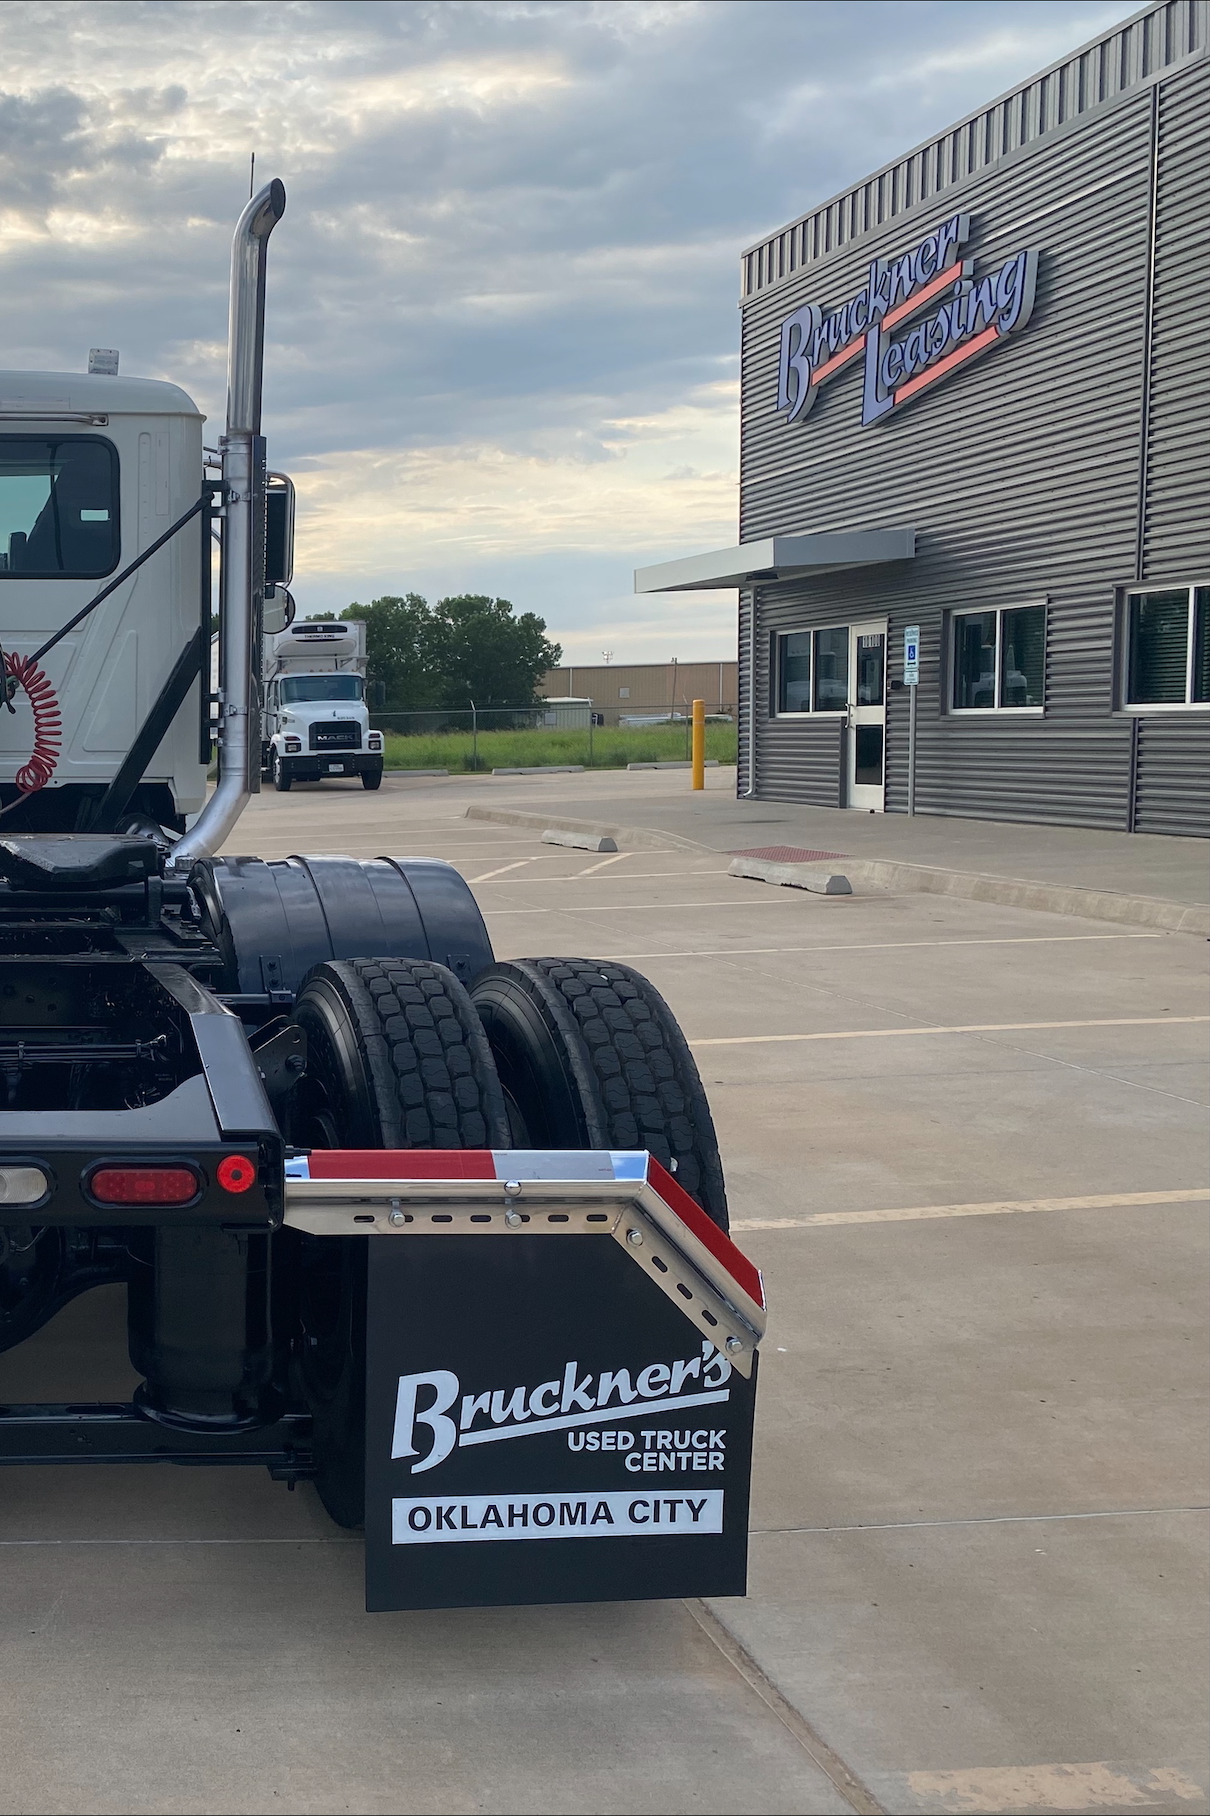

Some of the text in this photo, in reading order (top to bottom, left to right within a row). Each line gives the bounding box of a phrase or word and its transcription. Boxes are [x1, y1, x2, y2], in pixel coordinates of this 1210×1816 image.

[777, 214, 968, 423] Bruckner
[862, 250, 1035, 427] Leasing
[390, 1340, 732, 1474] Bruckner's
[568, 1429, 727, 1451] USED TRUCK
[624, 1452, 725, 1472] CENTER
[407, 1497, 708, 1532] OKLAHOMA CITY
